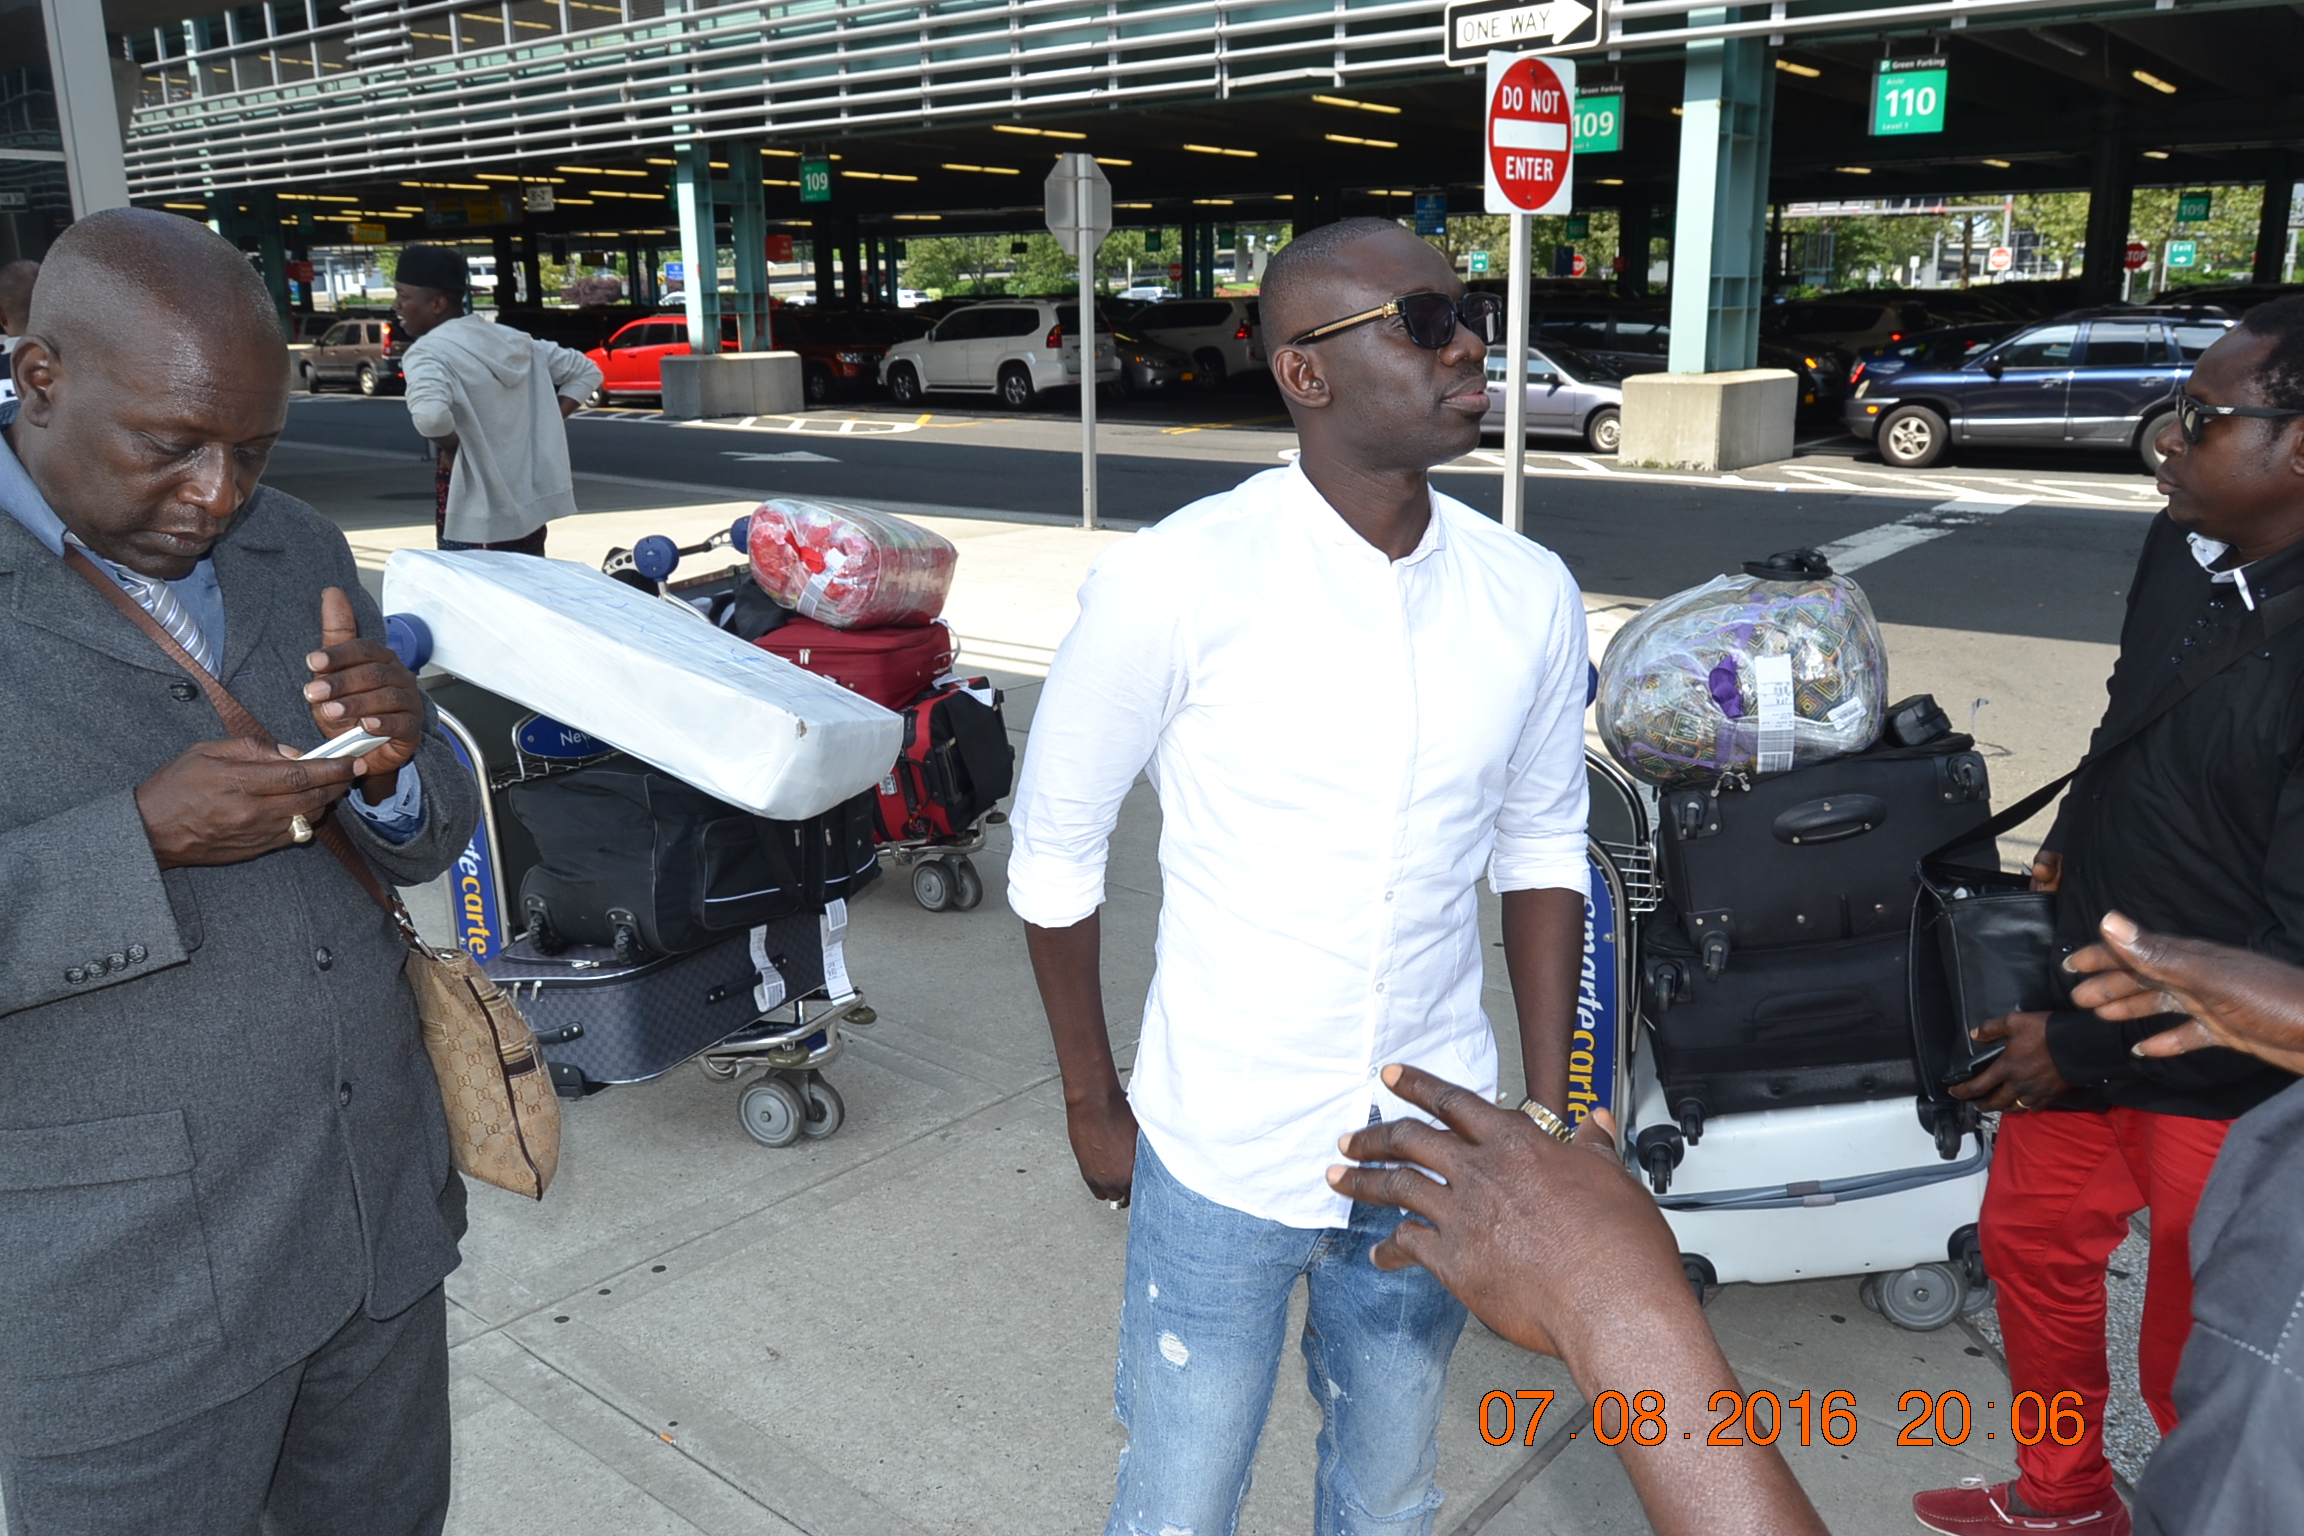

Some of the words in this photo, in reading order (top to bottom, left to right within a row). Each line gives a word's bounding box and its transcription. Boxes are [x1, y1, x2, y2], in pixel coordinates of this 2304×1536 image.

[1463, 17, 1500, 42] ONE
[1511, 10, 1550, 35] WAY
[1892, 61, 1915, 69] Green
[1916, 58, 1946, 67] Parking
[1601, 85, 1623, 93] Parking
[1502, 85, 1523, 111] DO
[1531, 89, 1560, 114] NOT
[1885, 86, 1936, 118] 110
[1573, 111, 1614, 138] 109
[1882, 122, 1902, 131] Level
[1506, 156, 1554, 181] ENTER
[805, 172, 828, 191] 109
[2181, 204, 2206, 217] 109
[2172, 243, 2192, 252] Exit
